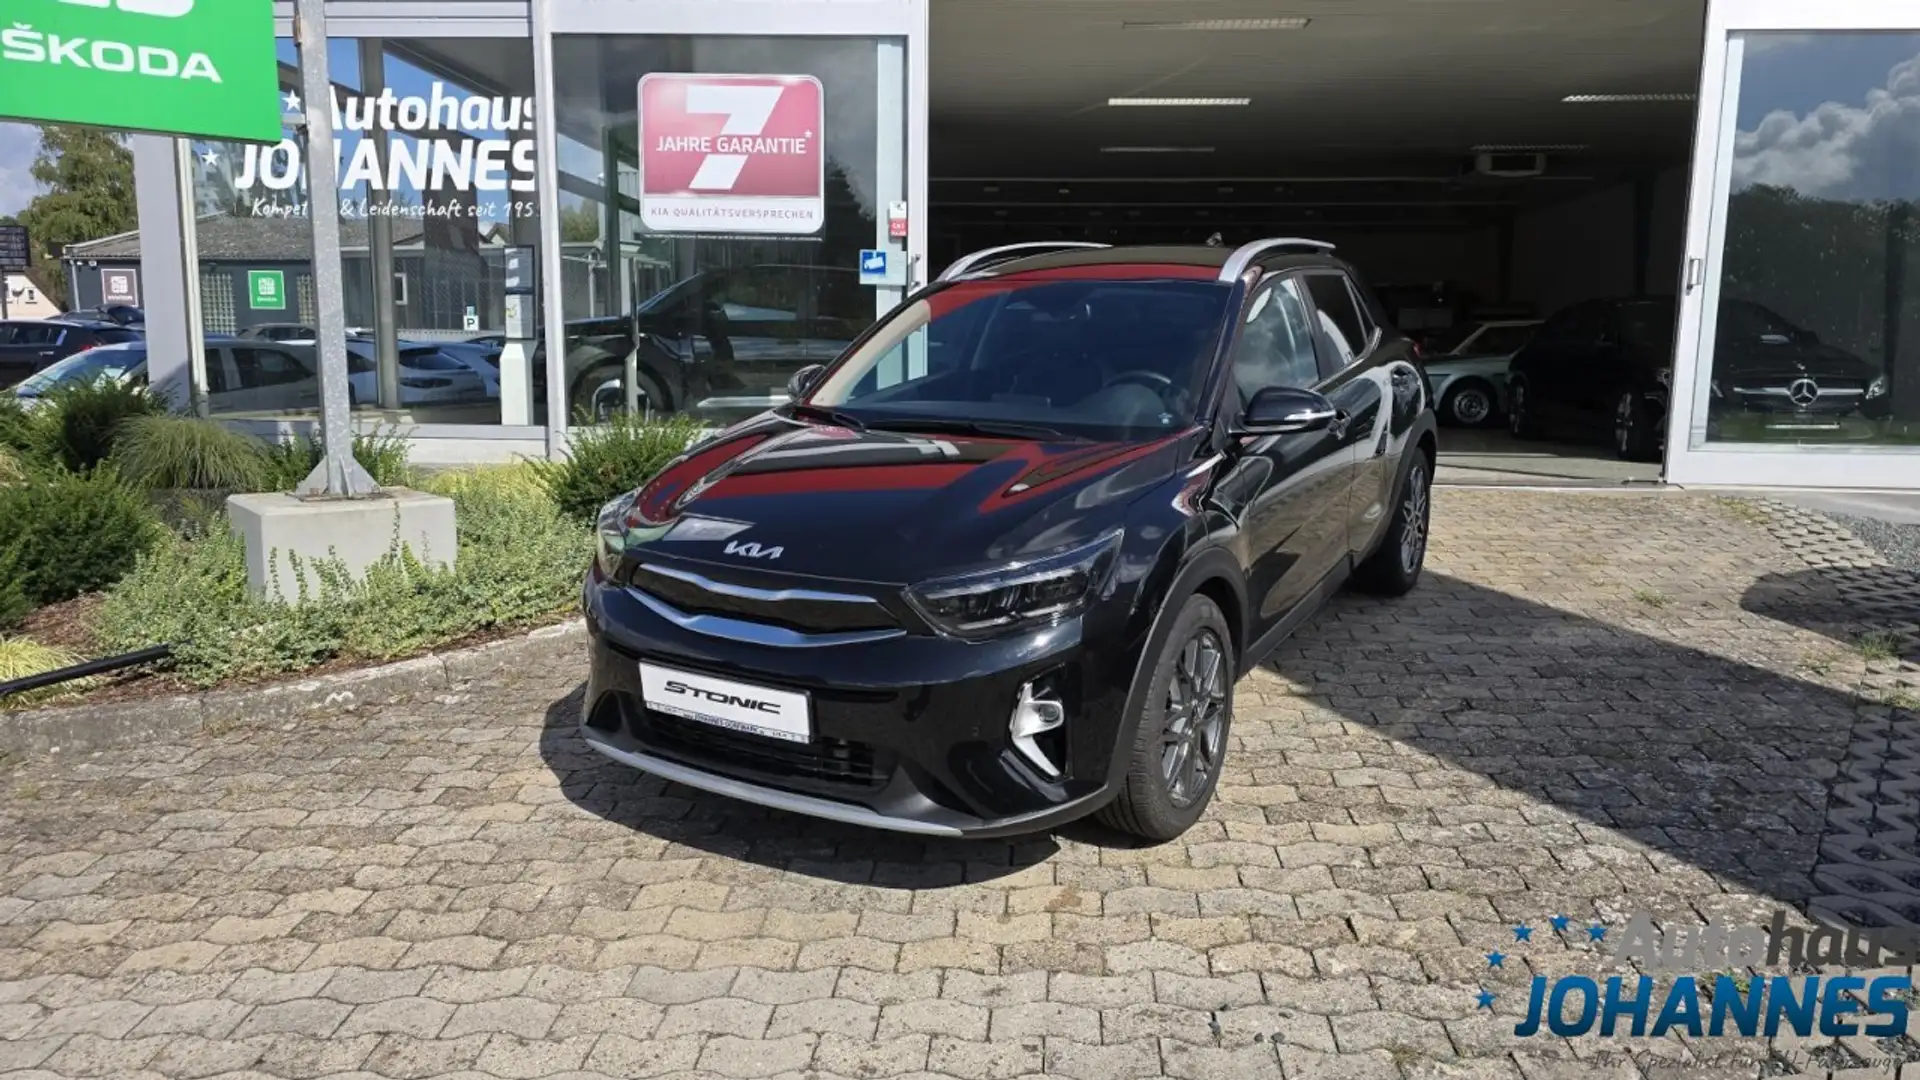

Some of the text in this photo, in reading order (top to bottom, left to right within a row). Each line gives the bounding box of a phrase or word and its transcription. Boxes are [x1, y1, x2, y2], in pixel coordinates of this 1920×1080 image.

[1, 21, 223, 84] ŠKODA
[656, 136, 712, 153] JAHRE
[685, 85, 785, 190] 7
[234, 138, 535, 192] JOANNES
[340, 198, 355, 217] &
[359, 197, 462, 219] Leidenschaft
[467, 200, 496, 217] seit
[503, 200, 540, 217] 195
[651, 204, 813, 219] KIA QUALITÄTSVERSPRECHEN
[664, 680, 781, 715] STONIC
